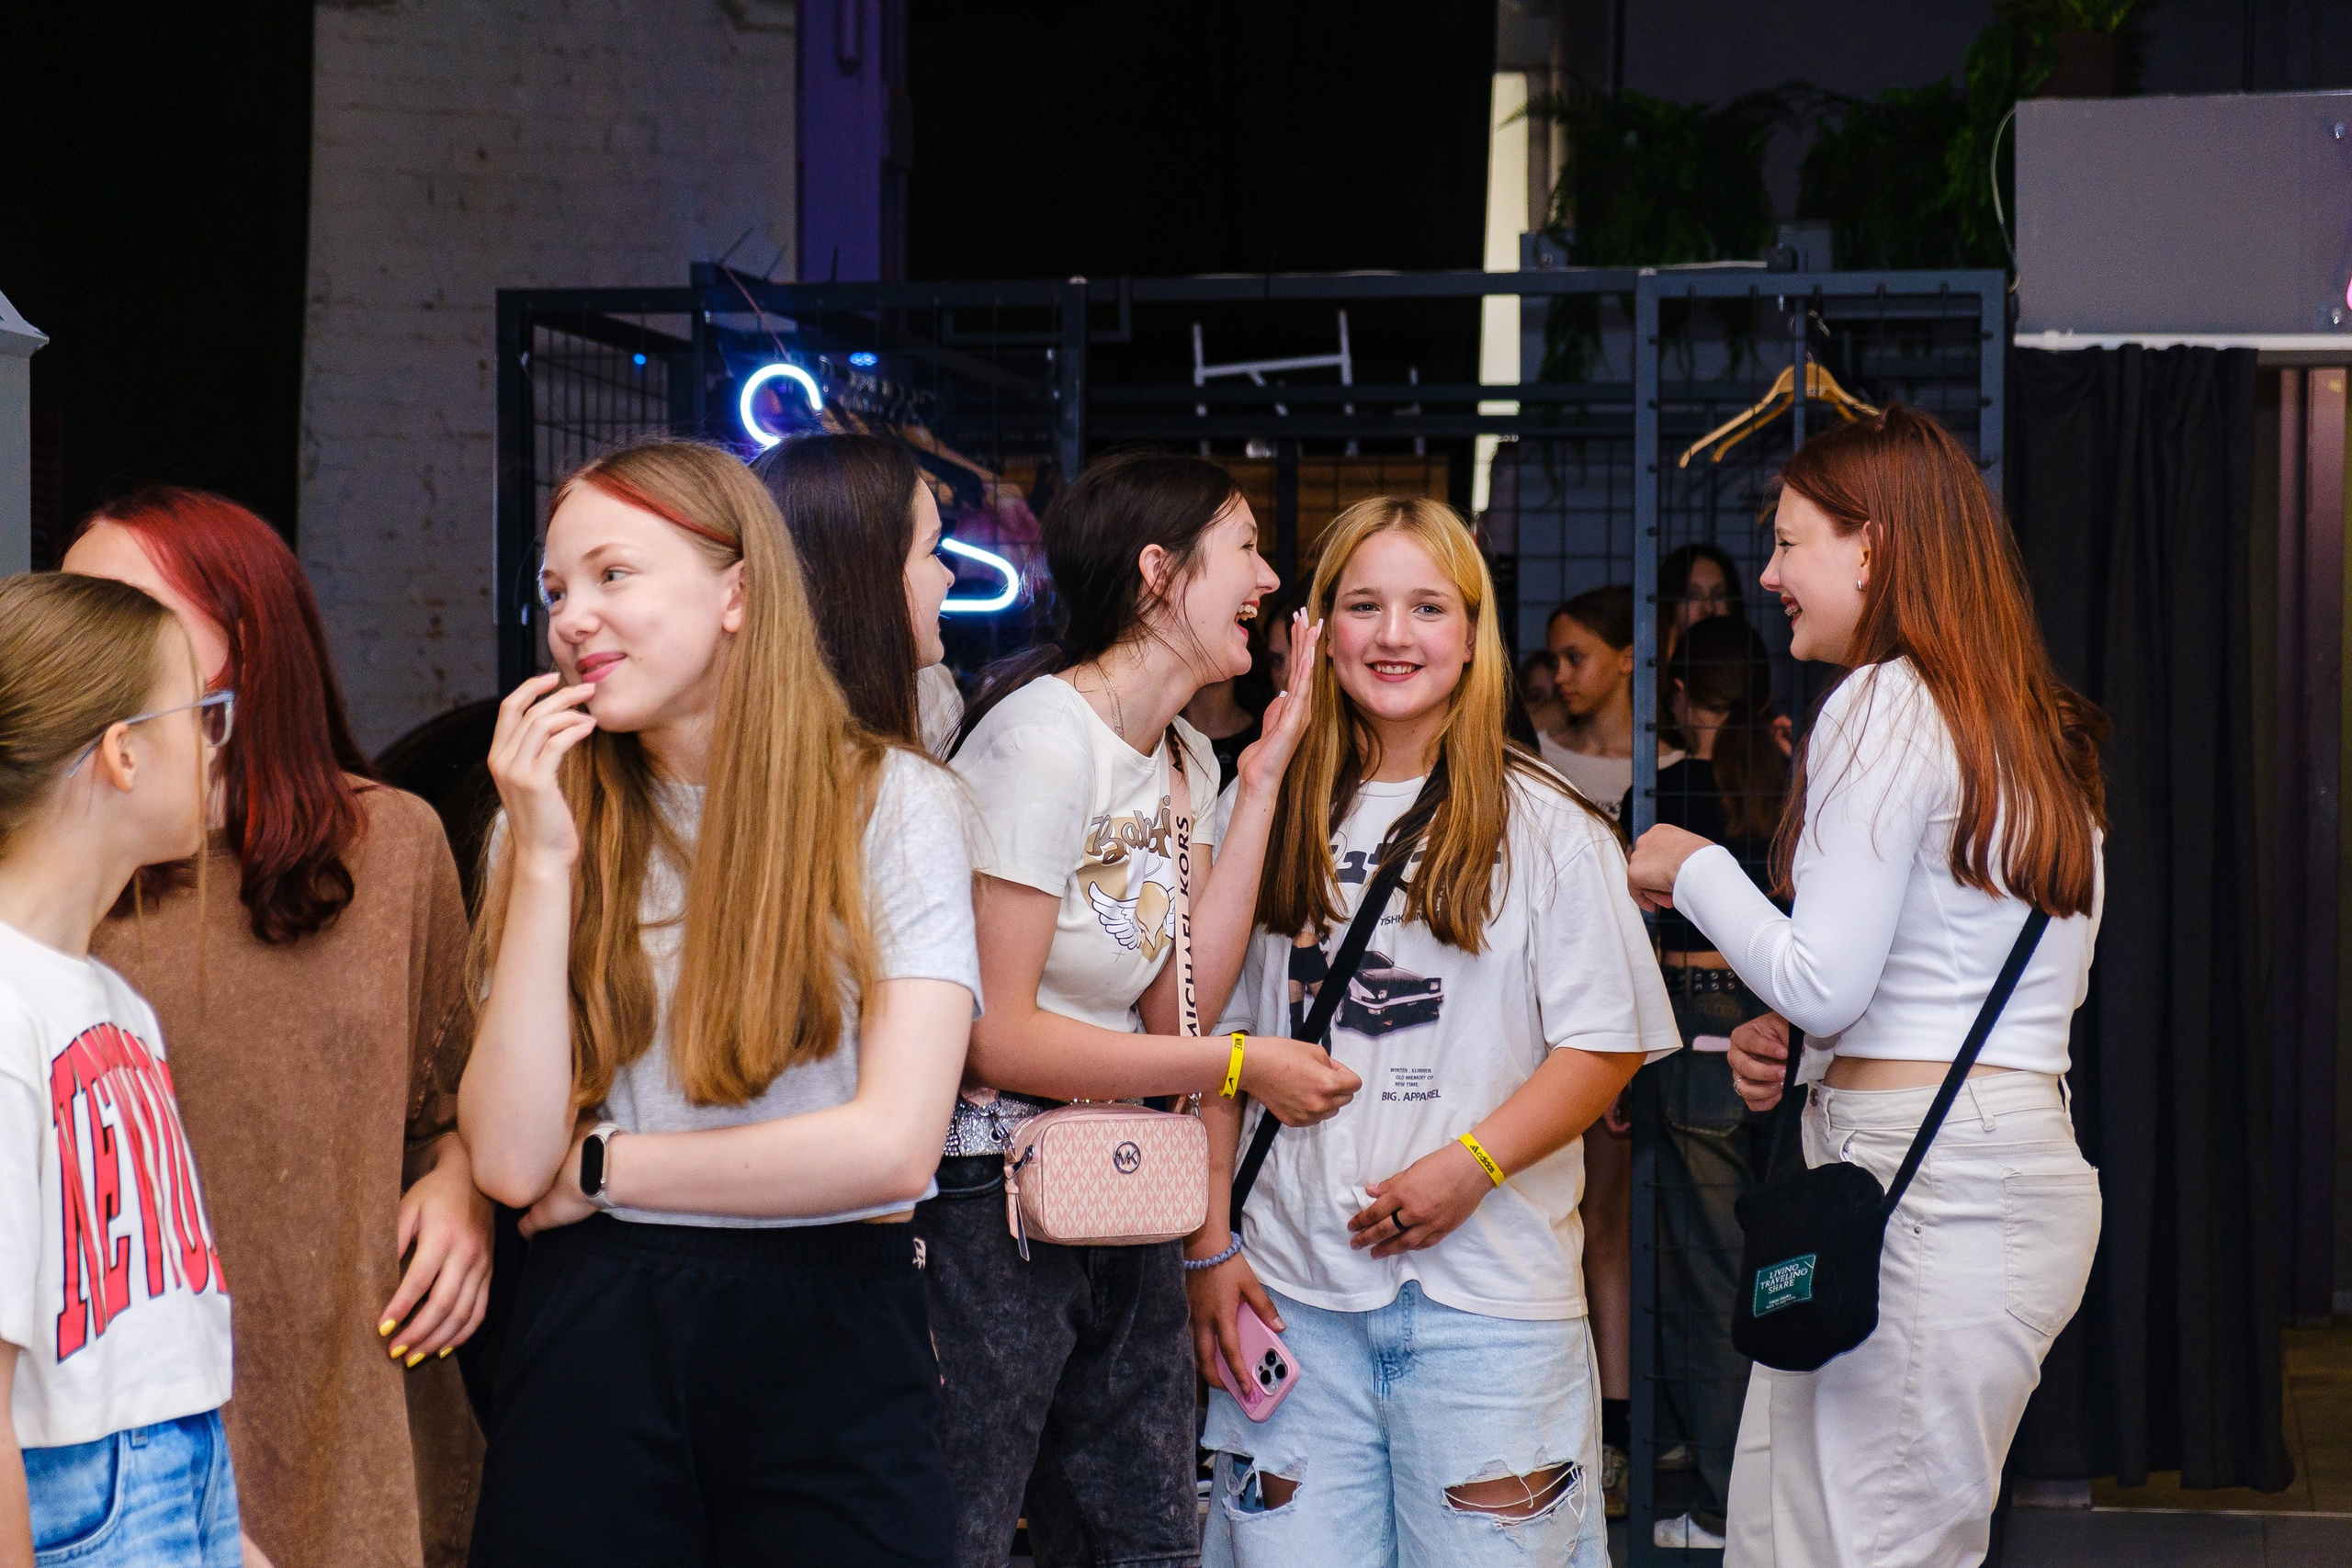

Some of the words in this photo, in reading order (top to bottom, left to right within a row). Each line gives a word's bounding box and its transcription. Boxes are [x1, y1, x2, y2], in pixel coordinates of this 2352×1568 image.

[1177, 816, 1190, 897] KORS
[1403, 1089, 1442, 1101] APPAREL
[1476, 1152, 1496, 1174] adidas
[1760, 1268, 1808, 1290] TRAVELING
[1770, 1263, 1799, 1279] LIVING
[1768, 1279, 1794, 1294] SHARE
